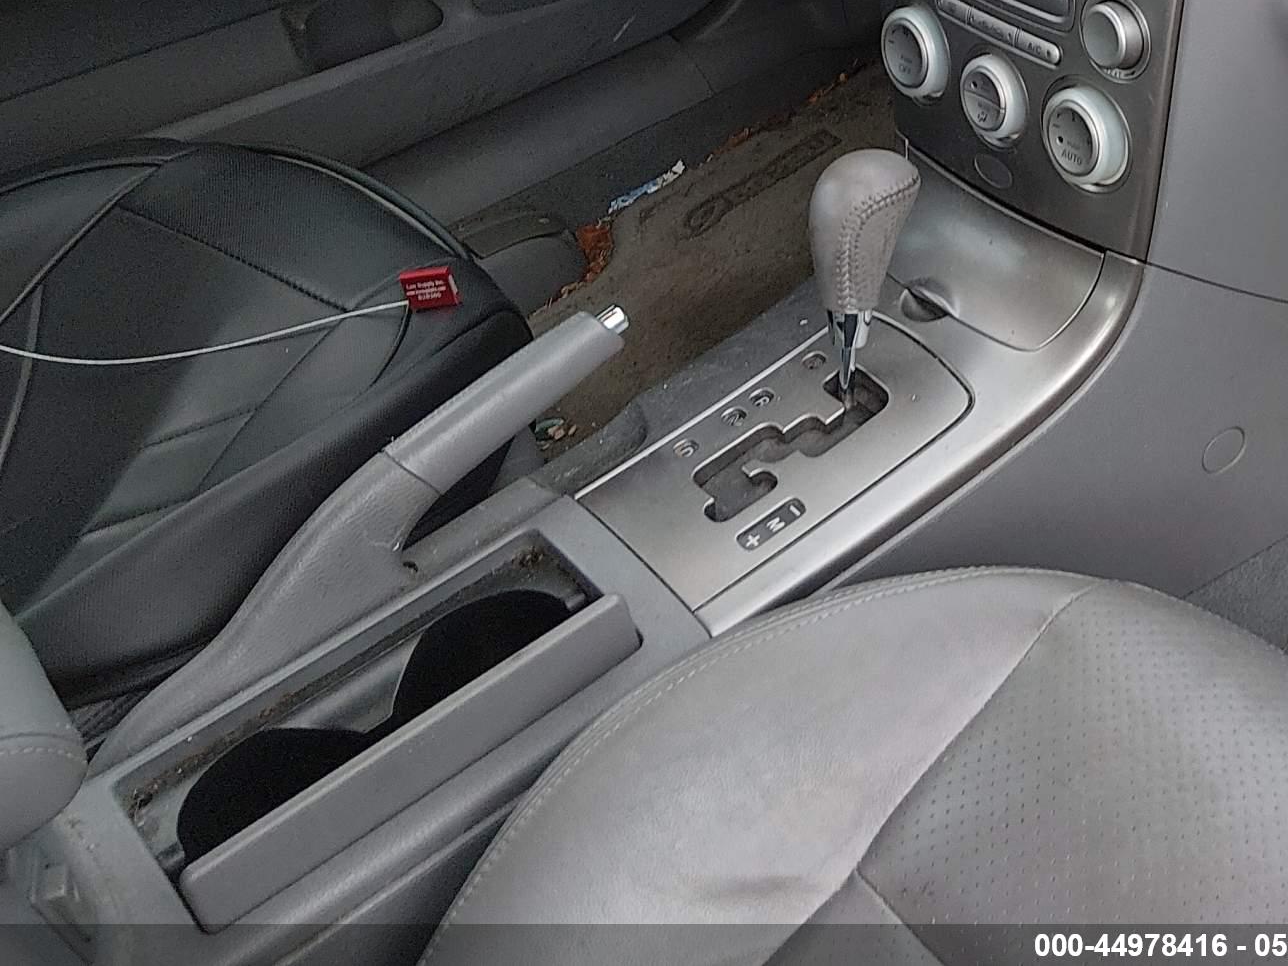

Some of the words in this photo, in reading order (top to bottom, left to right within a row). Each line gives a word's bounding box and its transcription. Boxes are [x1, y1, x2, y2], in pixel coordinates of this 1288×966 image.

[1028, 41, 1042, 55] A/C
[1061, 149, 1082, 165] AUTO
[766, 516, 786, 533] M
